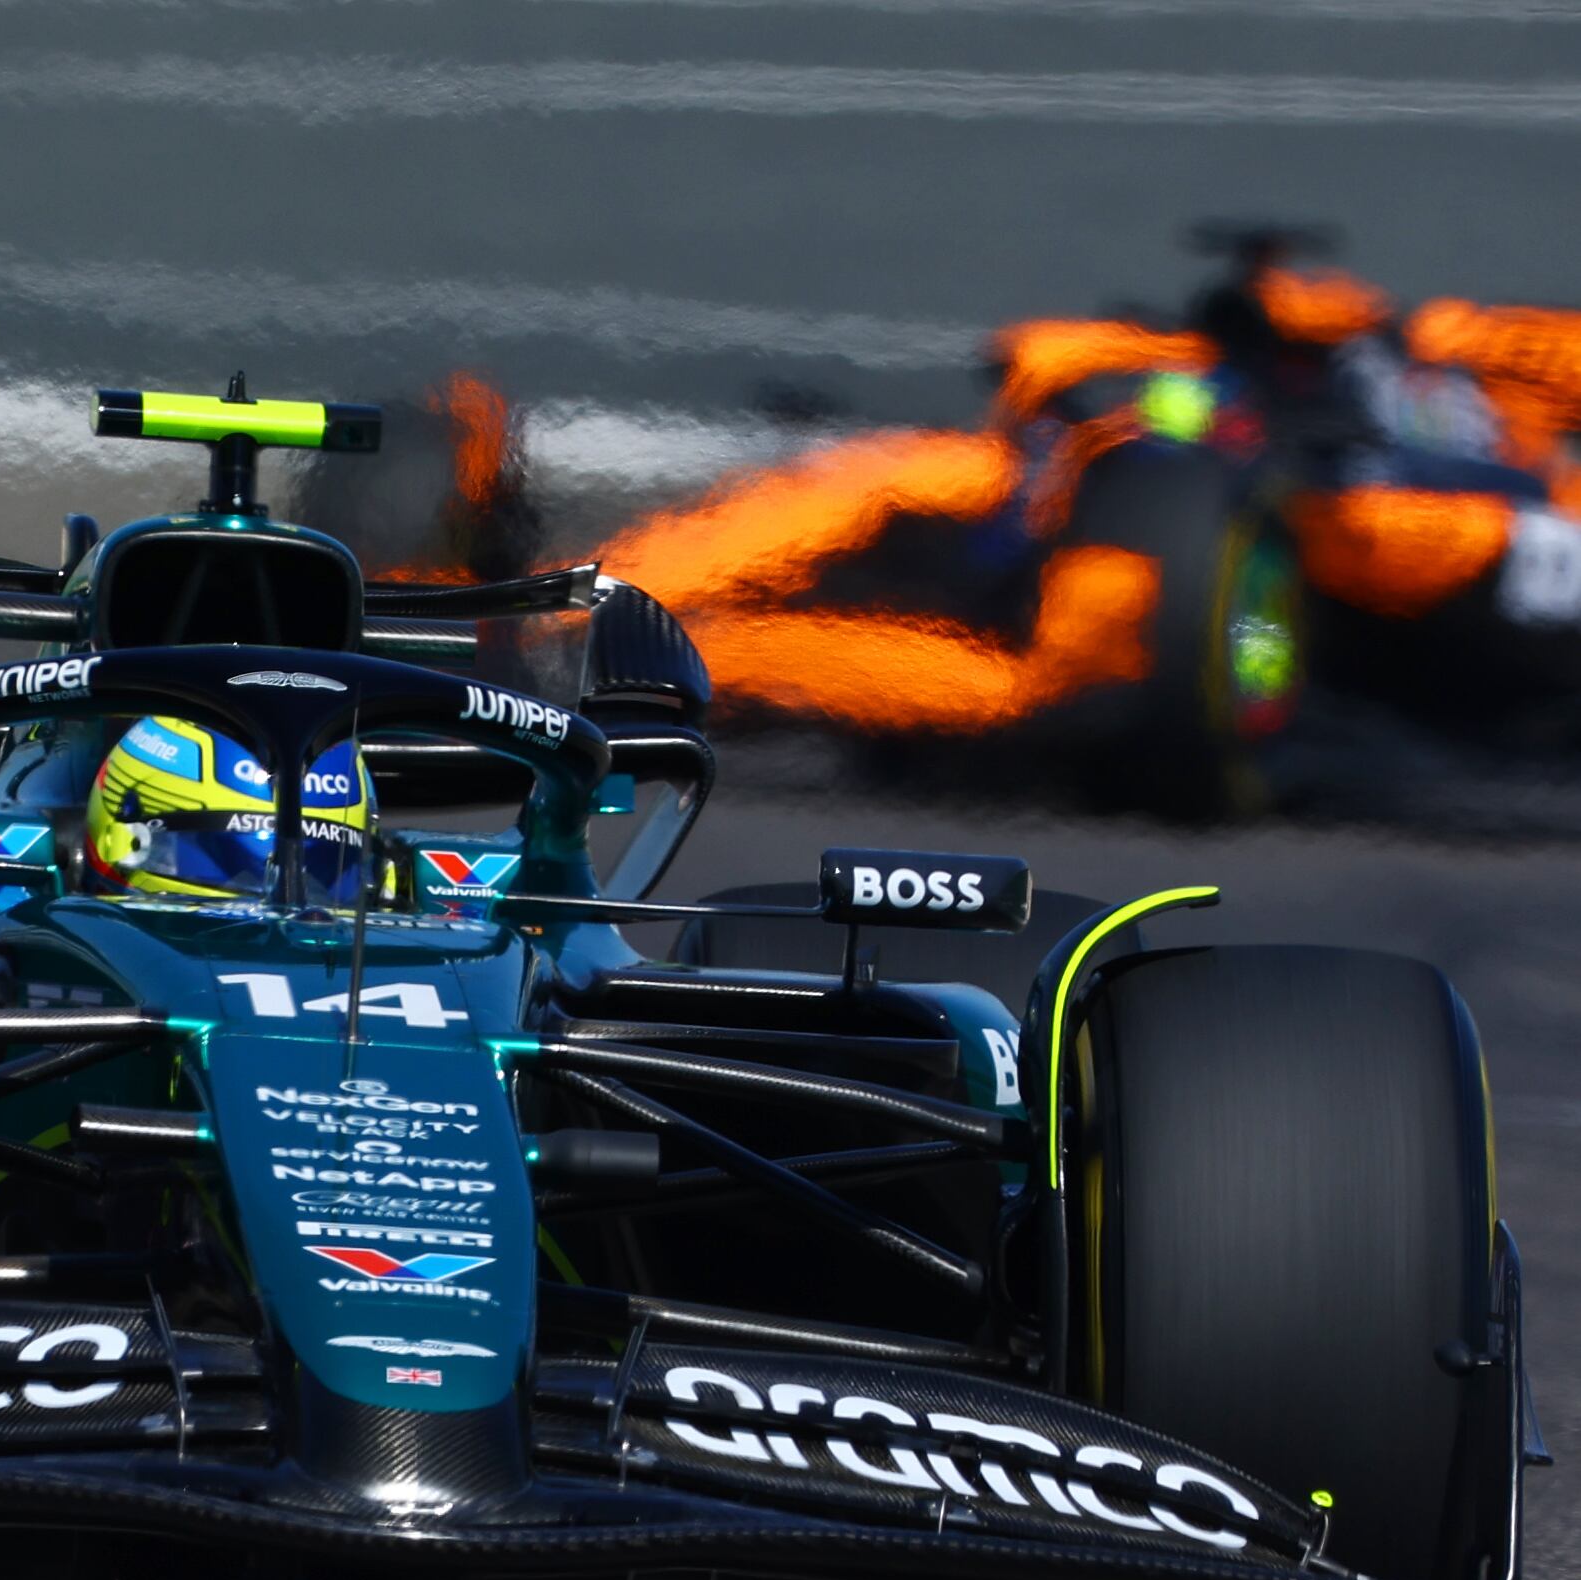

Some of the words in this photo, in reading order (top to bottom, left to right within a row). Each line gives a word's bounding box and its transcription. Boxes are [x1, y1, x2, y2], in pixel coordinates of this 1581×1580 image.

[300, 819, 363, 848] MARTIN
[852, 866, 985, 912] BOSS
[217, 973, 469, 1028] 14
[256, 1086, 479, 1117] NexGen
[263, 1108, 480, 1134] VELOCITY
[316, 1123, 431, 1140] BLACK
[270, 1147, 489, 1171] servicenow
[272, 1164, 497, 1194] NetApp
[319, 1278, 491, 1301] Valvoline
[665, 1366, 1260, 1549] aramco
